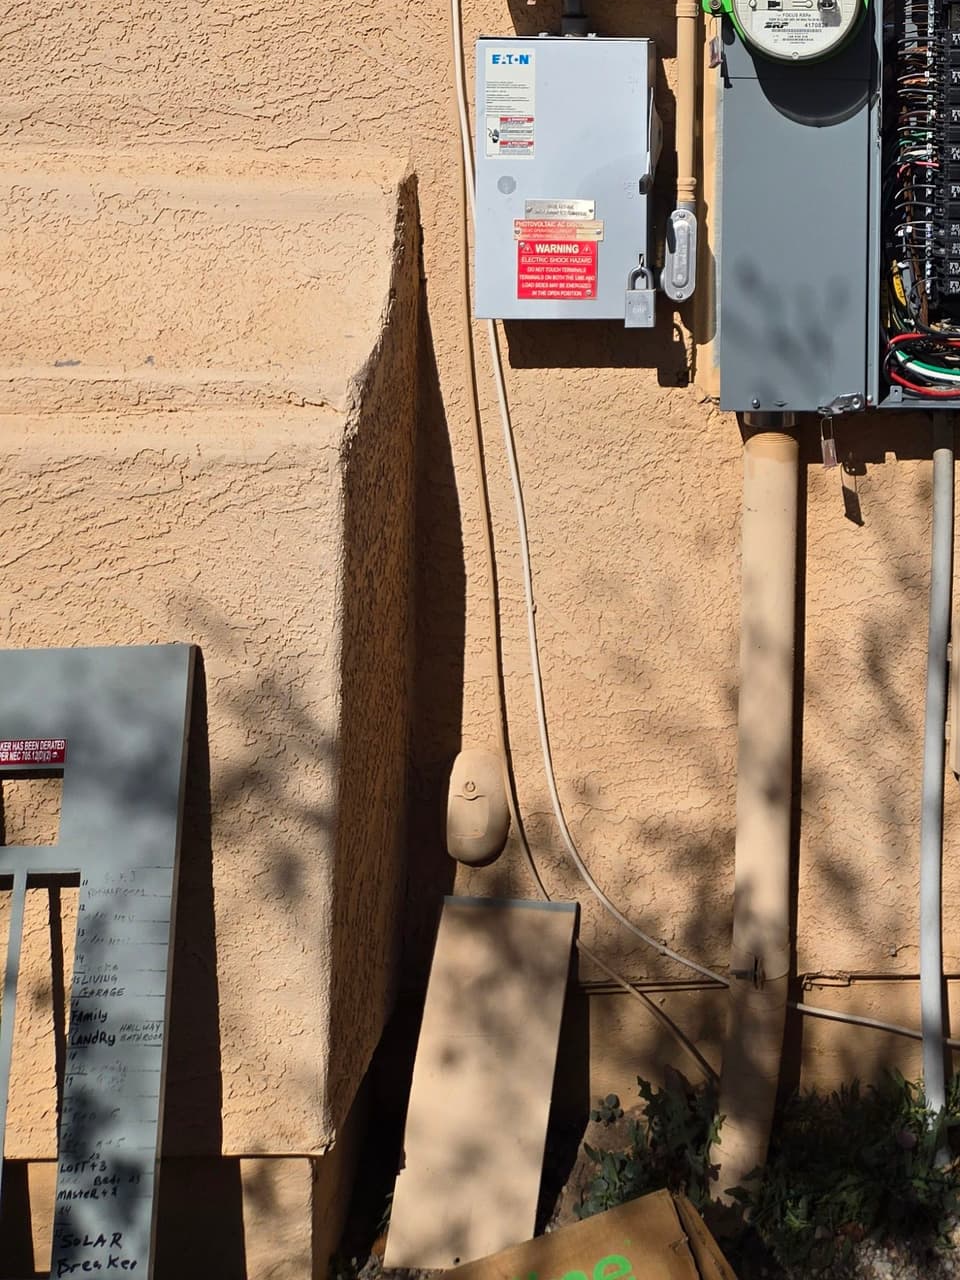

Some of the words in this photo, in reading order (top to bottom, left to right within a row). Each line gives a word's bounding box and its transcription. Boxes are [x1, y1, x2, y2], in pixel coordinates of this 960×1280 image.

[491, 54, 529, 65] EATON
[535, 243, 579, 254] WARNING
[521, 256, 549, 264] ELECTRIC
[549, 256, 569, 264] SHOCK
[12, 741, 25, 751] HAS
[24, 741, 40, 751] BEEN
[40, 740, 65, 750] DERATED
[9, 751, 21, 761] NEC
[81, 974, 118, 986] LIVING
